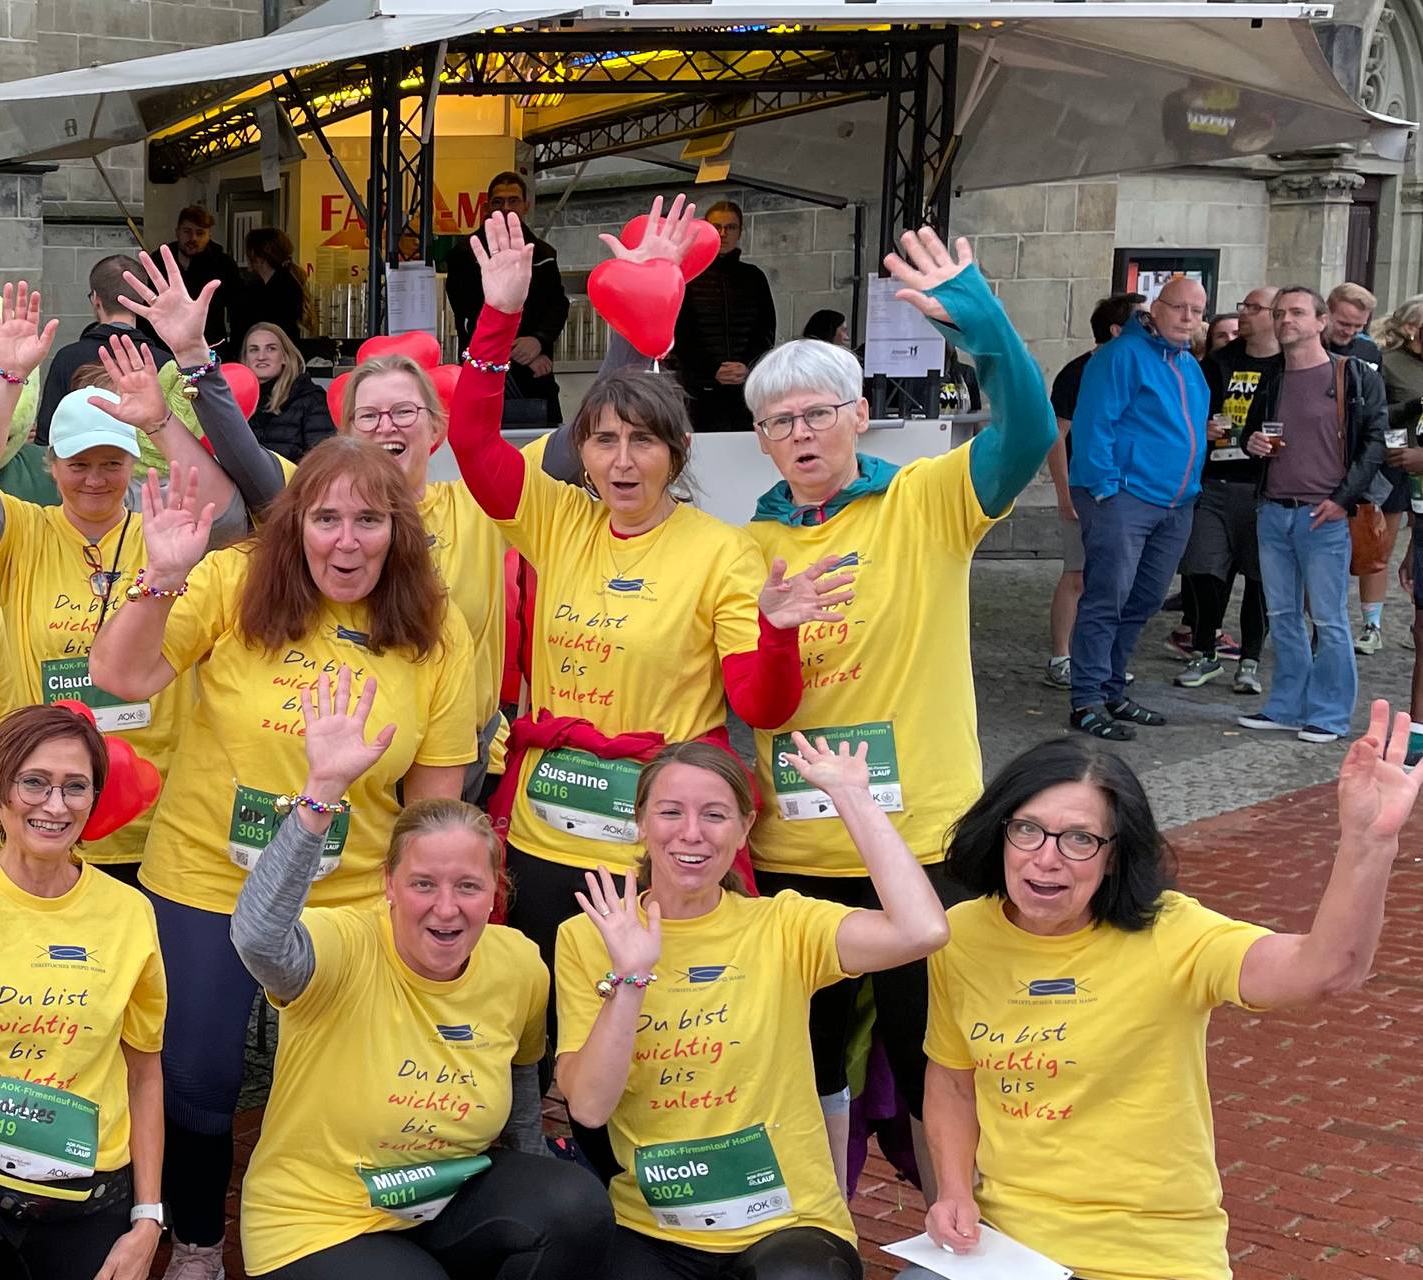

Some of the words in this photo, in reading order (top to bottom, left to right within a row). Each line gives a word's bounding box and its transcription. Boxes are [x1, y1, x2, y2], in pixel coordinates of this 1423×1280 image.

[54, 594, 80, 610] Du
[555, 604, 579, 623] Du
[586, 612, 628, 628] bist
[284, 650, 315, 669] Du
[561, 657, 587, 676] bis
[48, 673, 93, 689] Claud
[117, 712, 136, 721] AOK
[262, 719, 306, 736] zule
[857, 728, 887, 737] Hamm
[538, 763, 608, 790] Susanne
[780, 770, 805, 784] 302
[534, 781, 568, 798] 3016
[238, 824, 272, 842] 3031
[603, 825, 623, 835] AOK
[42, 987, 88, 1006] bist
[678, 1003, 728, 1030] bist
[970, 1022, 1004, 1044] Du
[1014, 1022, 1067, 1044] bist
[9, 1041, 47, 1060] bis
[398, 1060, 428, 1080] Du
[436, 1065, 477, 1087] bist
[660, 1067, 695, 1085] bis
[1001, 1077, 1035, 1094] bis
[1, 1083, 70, 1105] AOK-Firmenlauf
[72, 1100, 95, 1114] Hamm
[650, 1086, 737, 1110] zuletzt
[401, 1117, 436, 1135] bis
[642, 1151, 655, 1160] 14.
[657, 1141, 730, 1158] AOK-Firmenlauf
[732, 1132, 761, 1146] Hamm
[47, 1168, 70, 1178] AOK
[372, 1165, 436, 1190] Miriam
[644, 1160, 709, 1183] Nicole
[758, 1174, 775, 1185] LAUF
[380, 1186, 416, 1206] 3011
[651, 1182, 694, 1200] 3024
[746, 1200, 770, 1214] AOK
